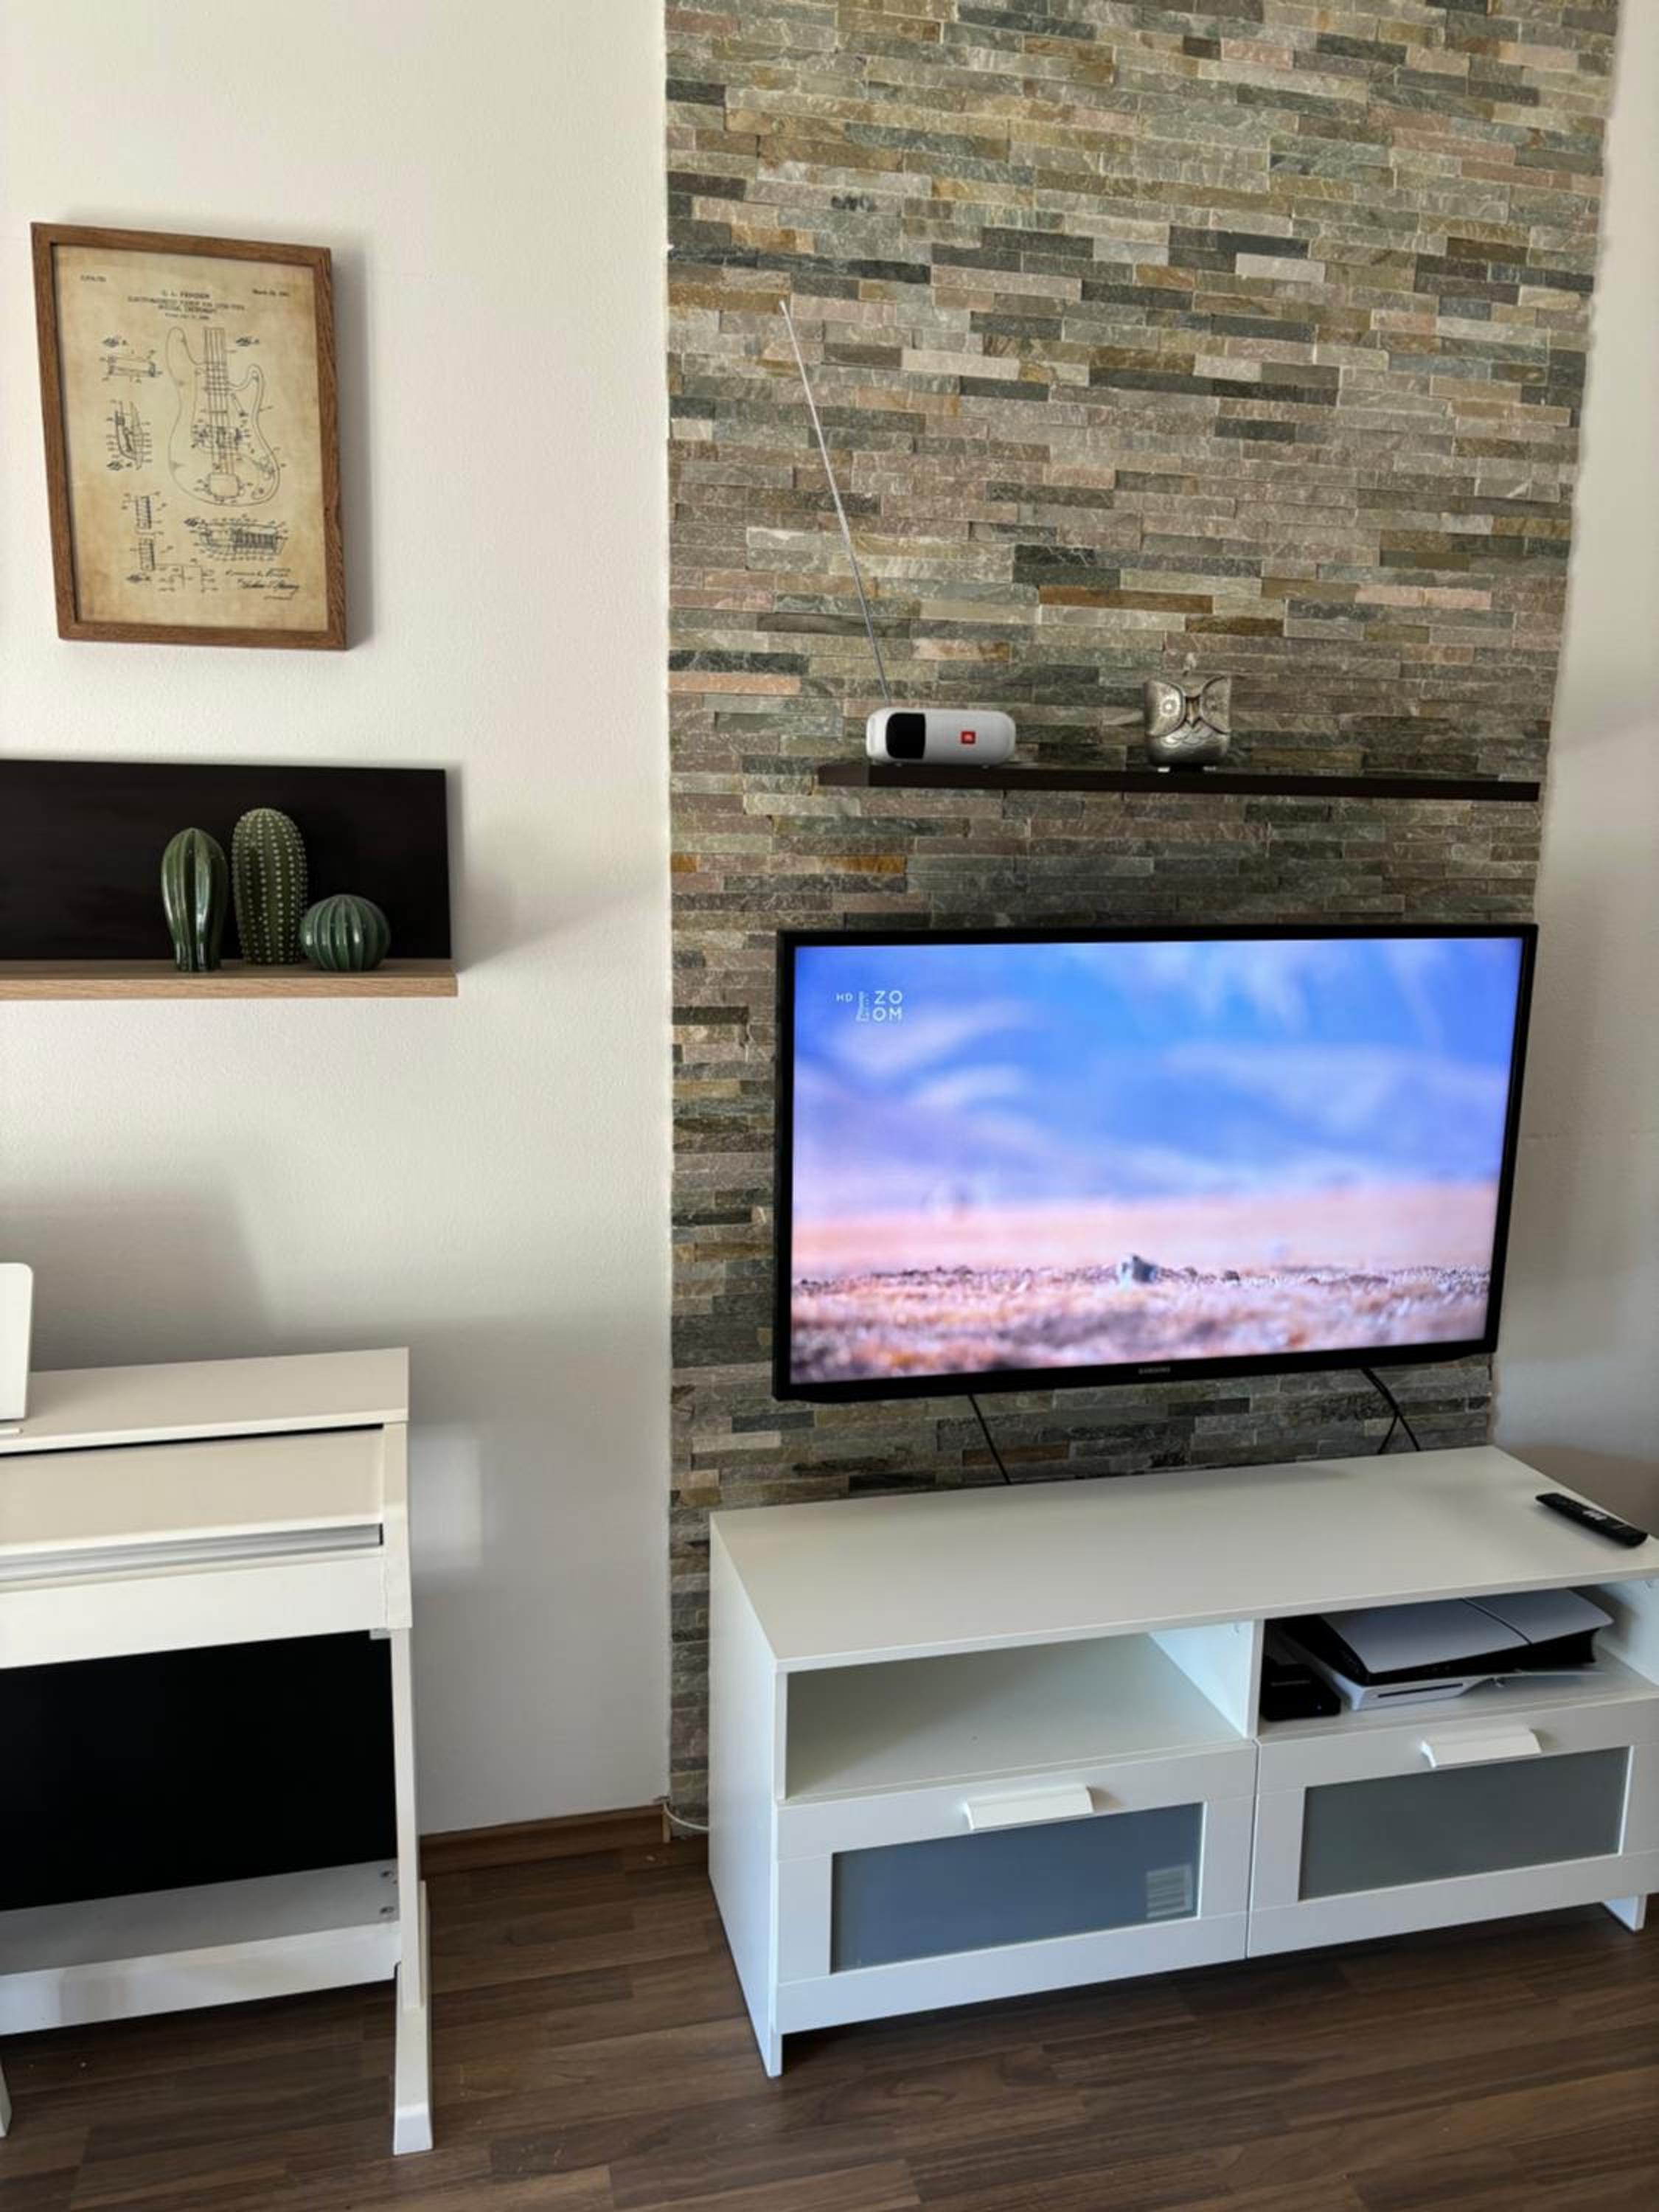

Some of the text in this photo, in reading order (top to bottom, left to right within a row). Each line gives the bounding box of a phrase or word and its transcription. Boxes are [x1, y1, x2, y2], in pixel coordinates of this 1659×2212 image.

[835, 992, 853, 1003] HD
[874, 990, 903, 1005] ZO
[872, 1006, 902, 1022] OM
